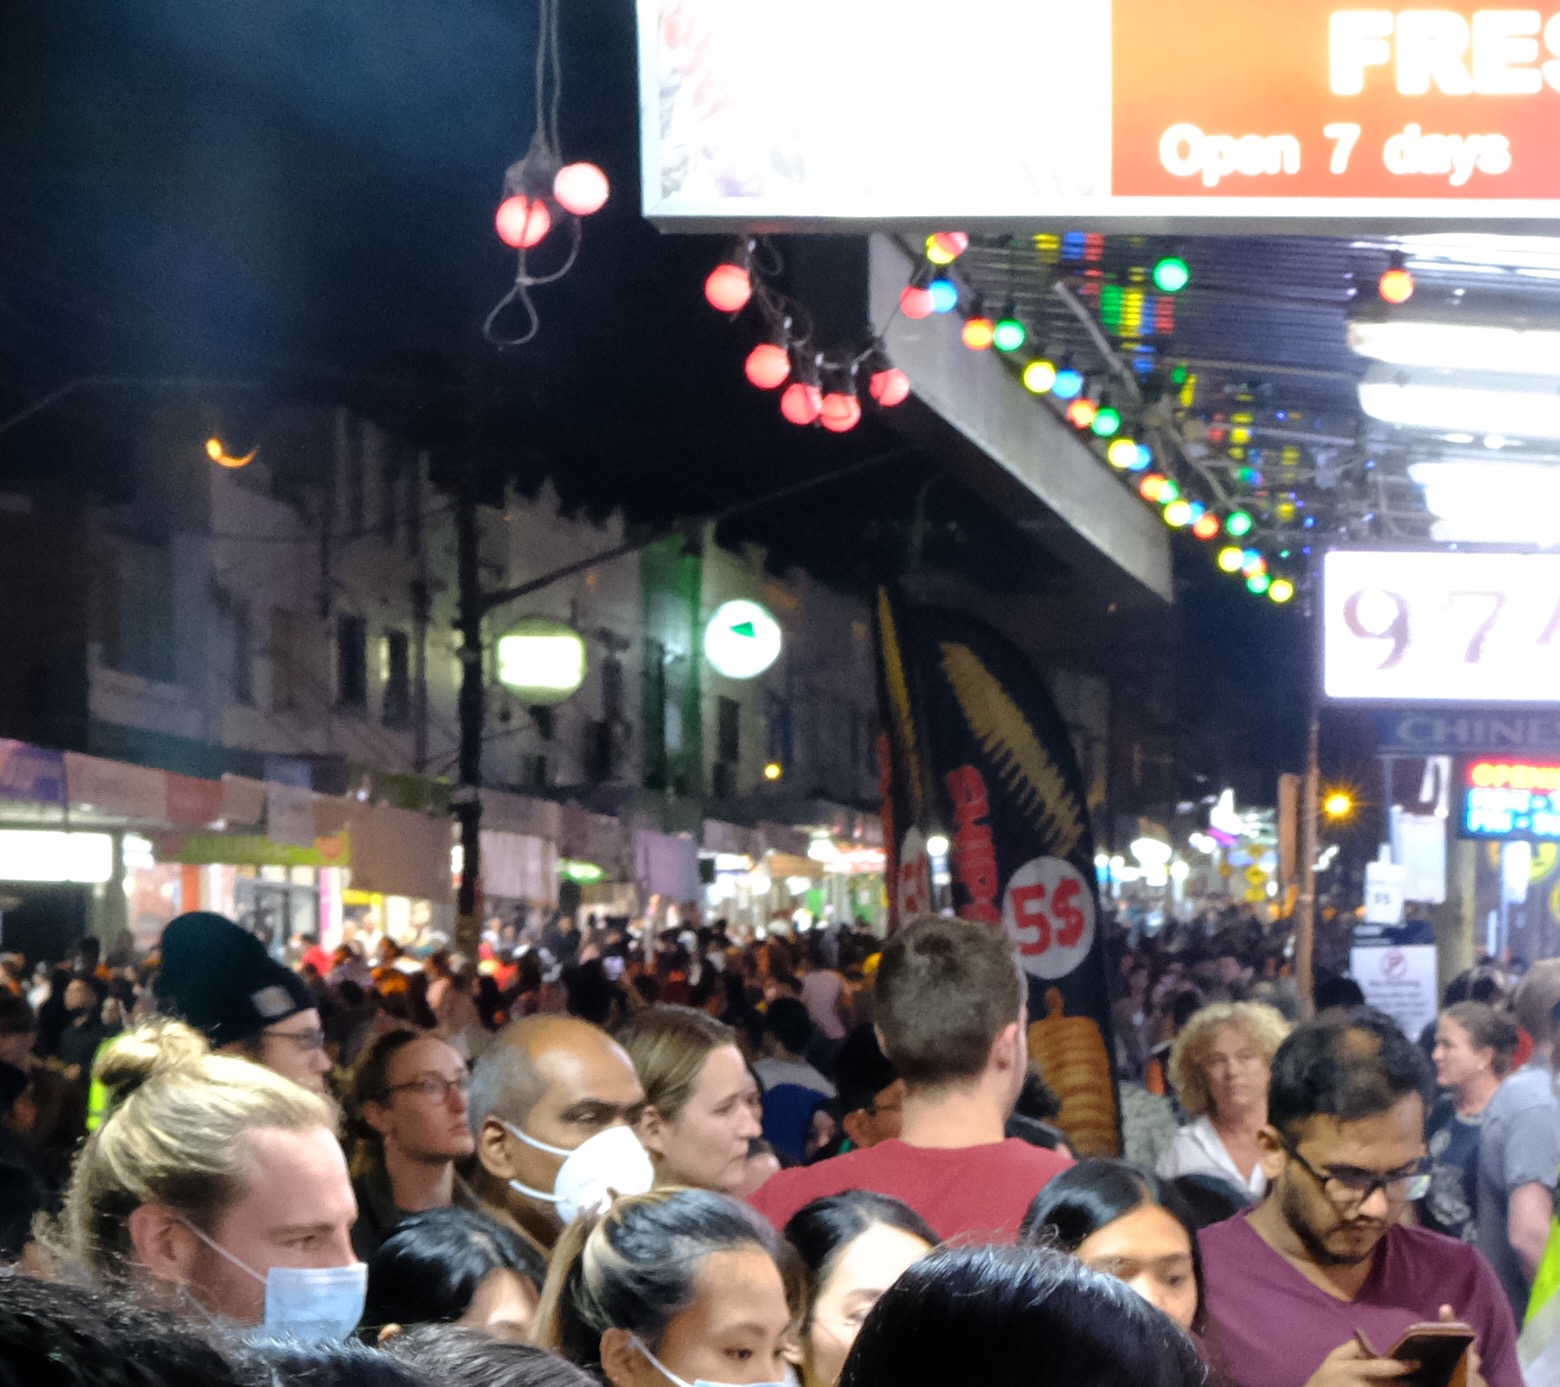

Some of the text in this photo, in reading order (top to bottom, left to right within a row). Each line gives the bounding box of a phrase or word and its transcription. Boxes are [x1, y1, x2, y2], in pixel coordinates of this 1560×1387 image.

[1159, 123, 1511, 187] Open 7 days
[1011, 879, 1084, 955] 5$
